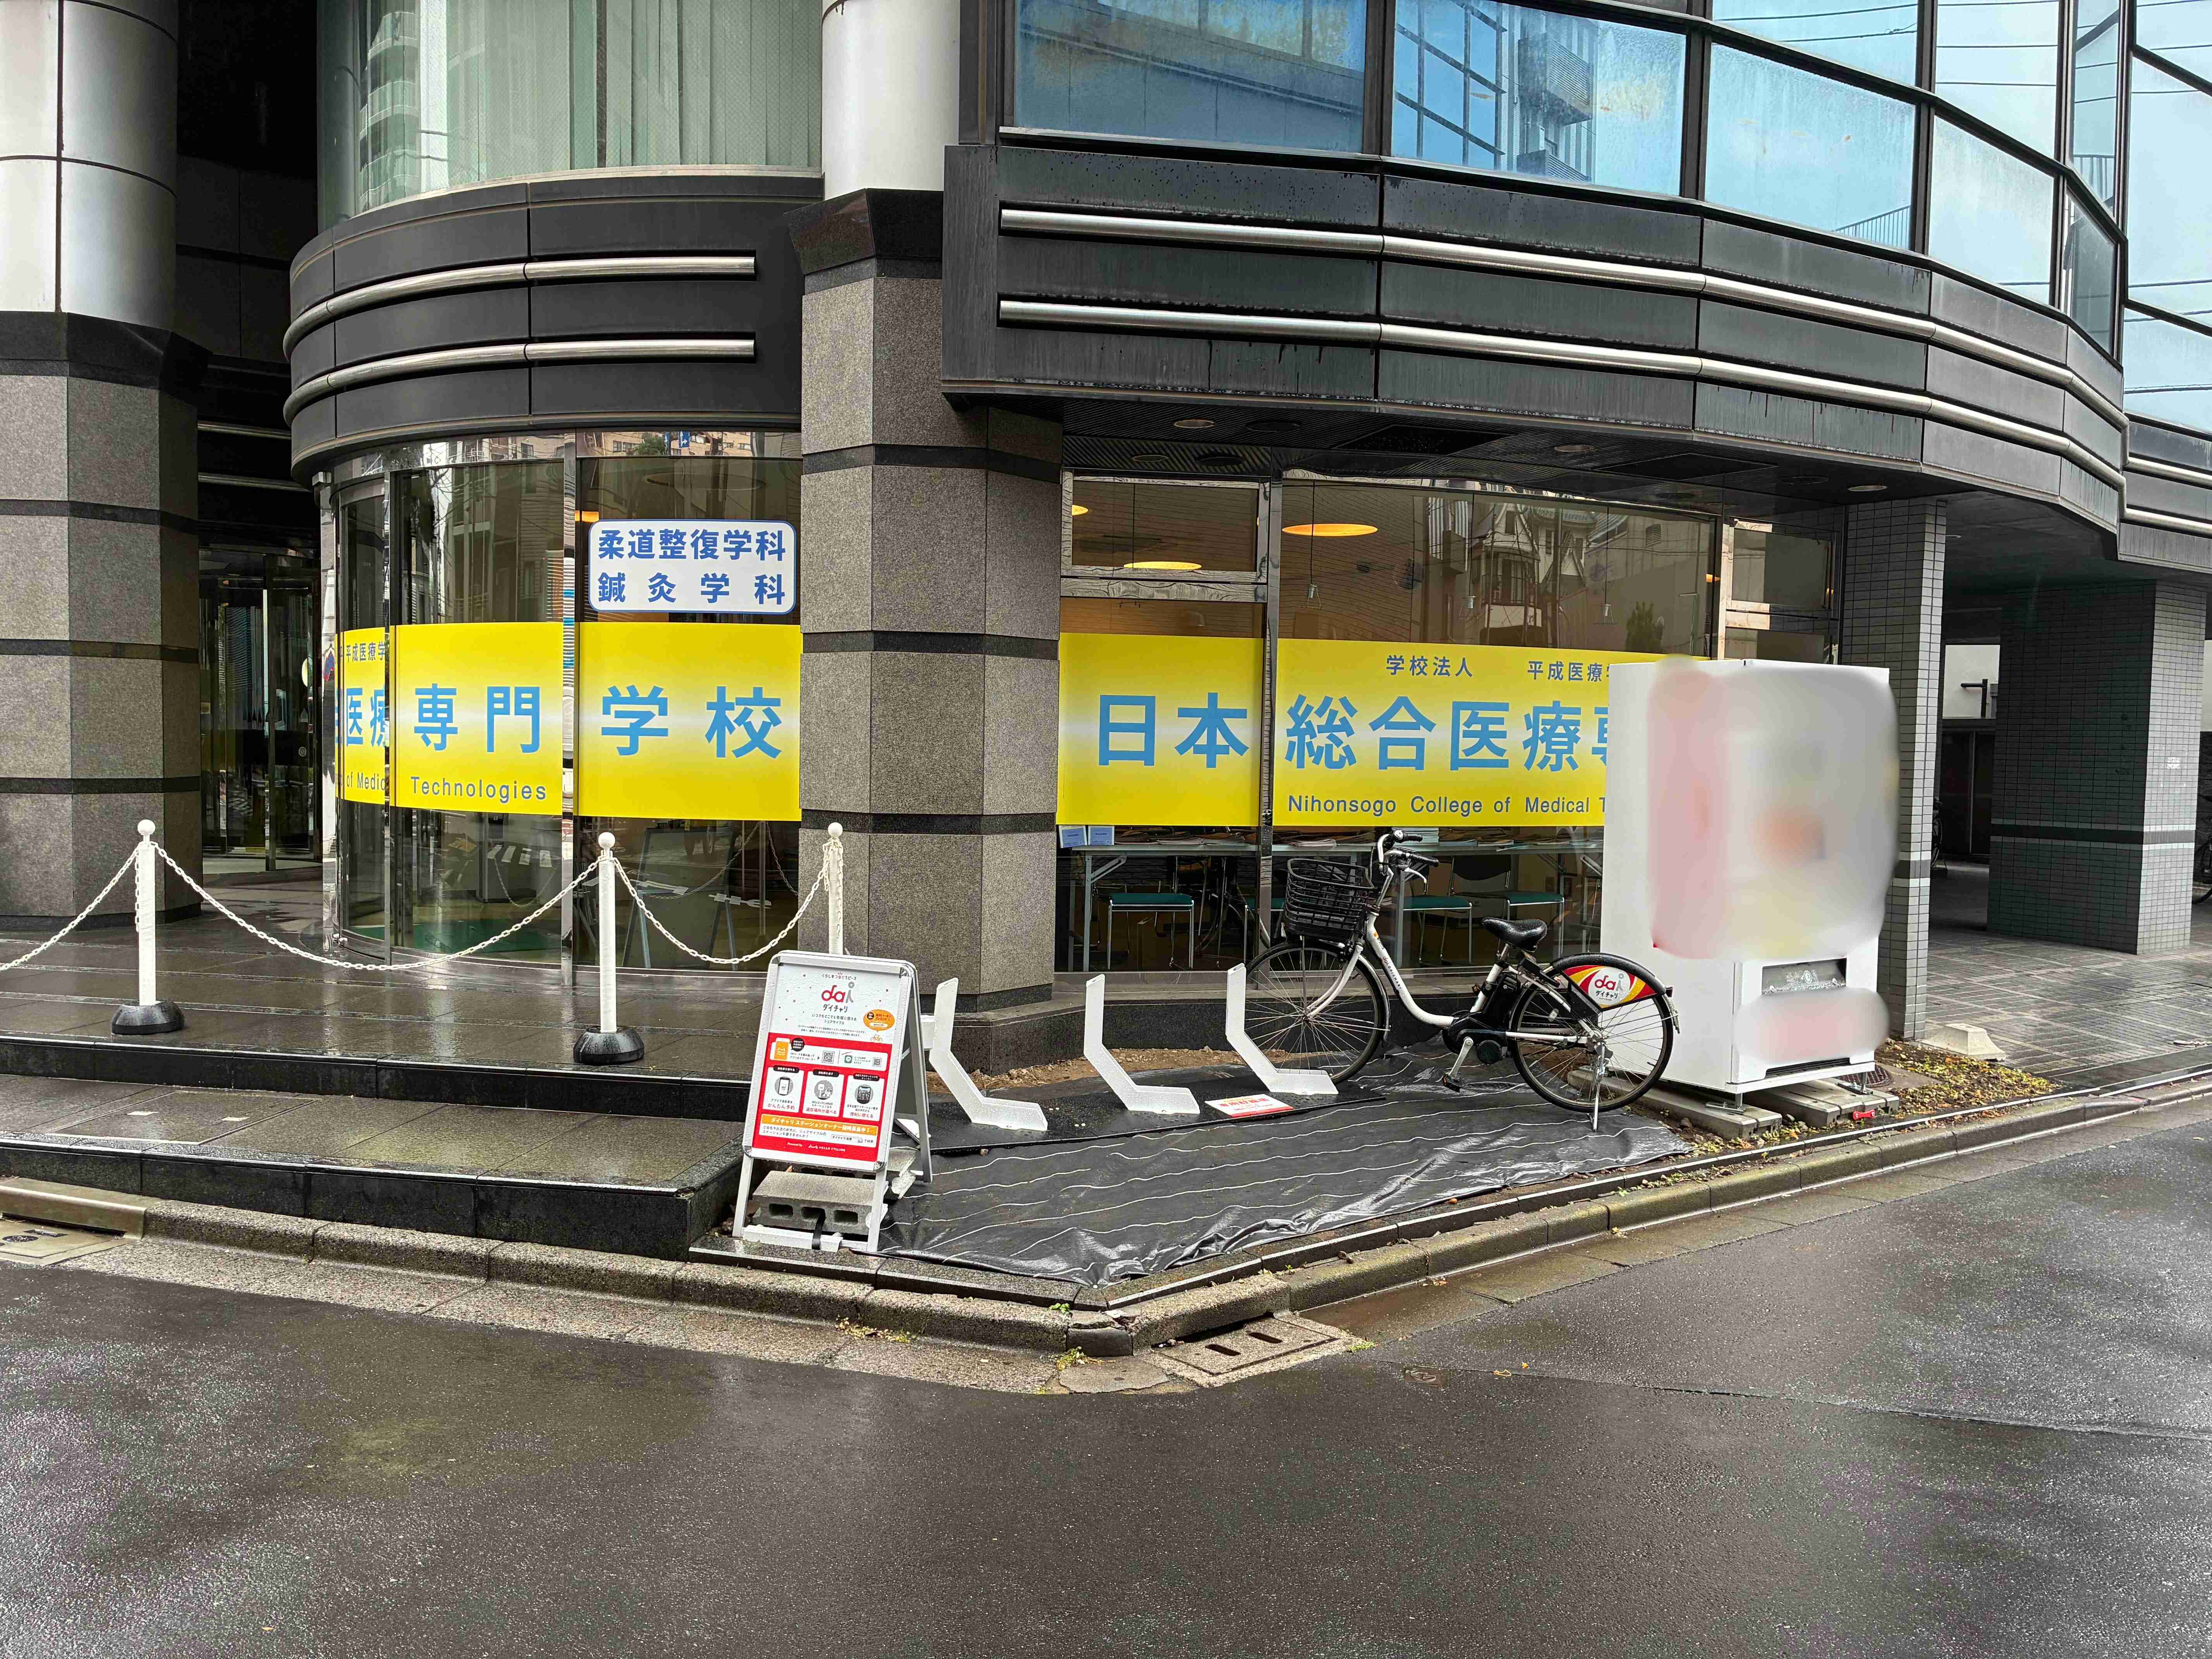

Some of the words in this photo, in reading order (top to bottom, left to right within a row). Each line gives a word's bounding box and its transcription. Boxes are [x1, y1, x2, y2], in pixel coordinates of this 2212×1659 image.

[598, 528, 786, 562] 柔道整復学科
[598, 572, 785, 605] 鍼灸学科
[1386, 655, 1473, 678] 学校法人
[1527, 660, 1609, 682] 平成医療
[1098, 692, 1607, 772] 日本総合医療
[347, 771, 353, 787] of
[357, 772, 385, 790] Medic
[410, 776, 547, 804] Technologies
[1288, 795, 1396, 816] Nihonsogo
[1410, 795, 1484, 816] College
[1492, 796, 1511, 814] of
[1525, 797, 1589, 814] Medical
[821, 982, 855, 1003] dai
[1594, 973, 1624, 991] dai
[823, 1004, 848, 1013] ダイチャリ
